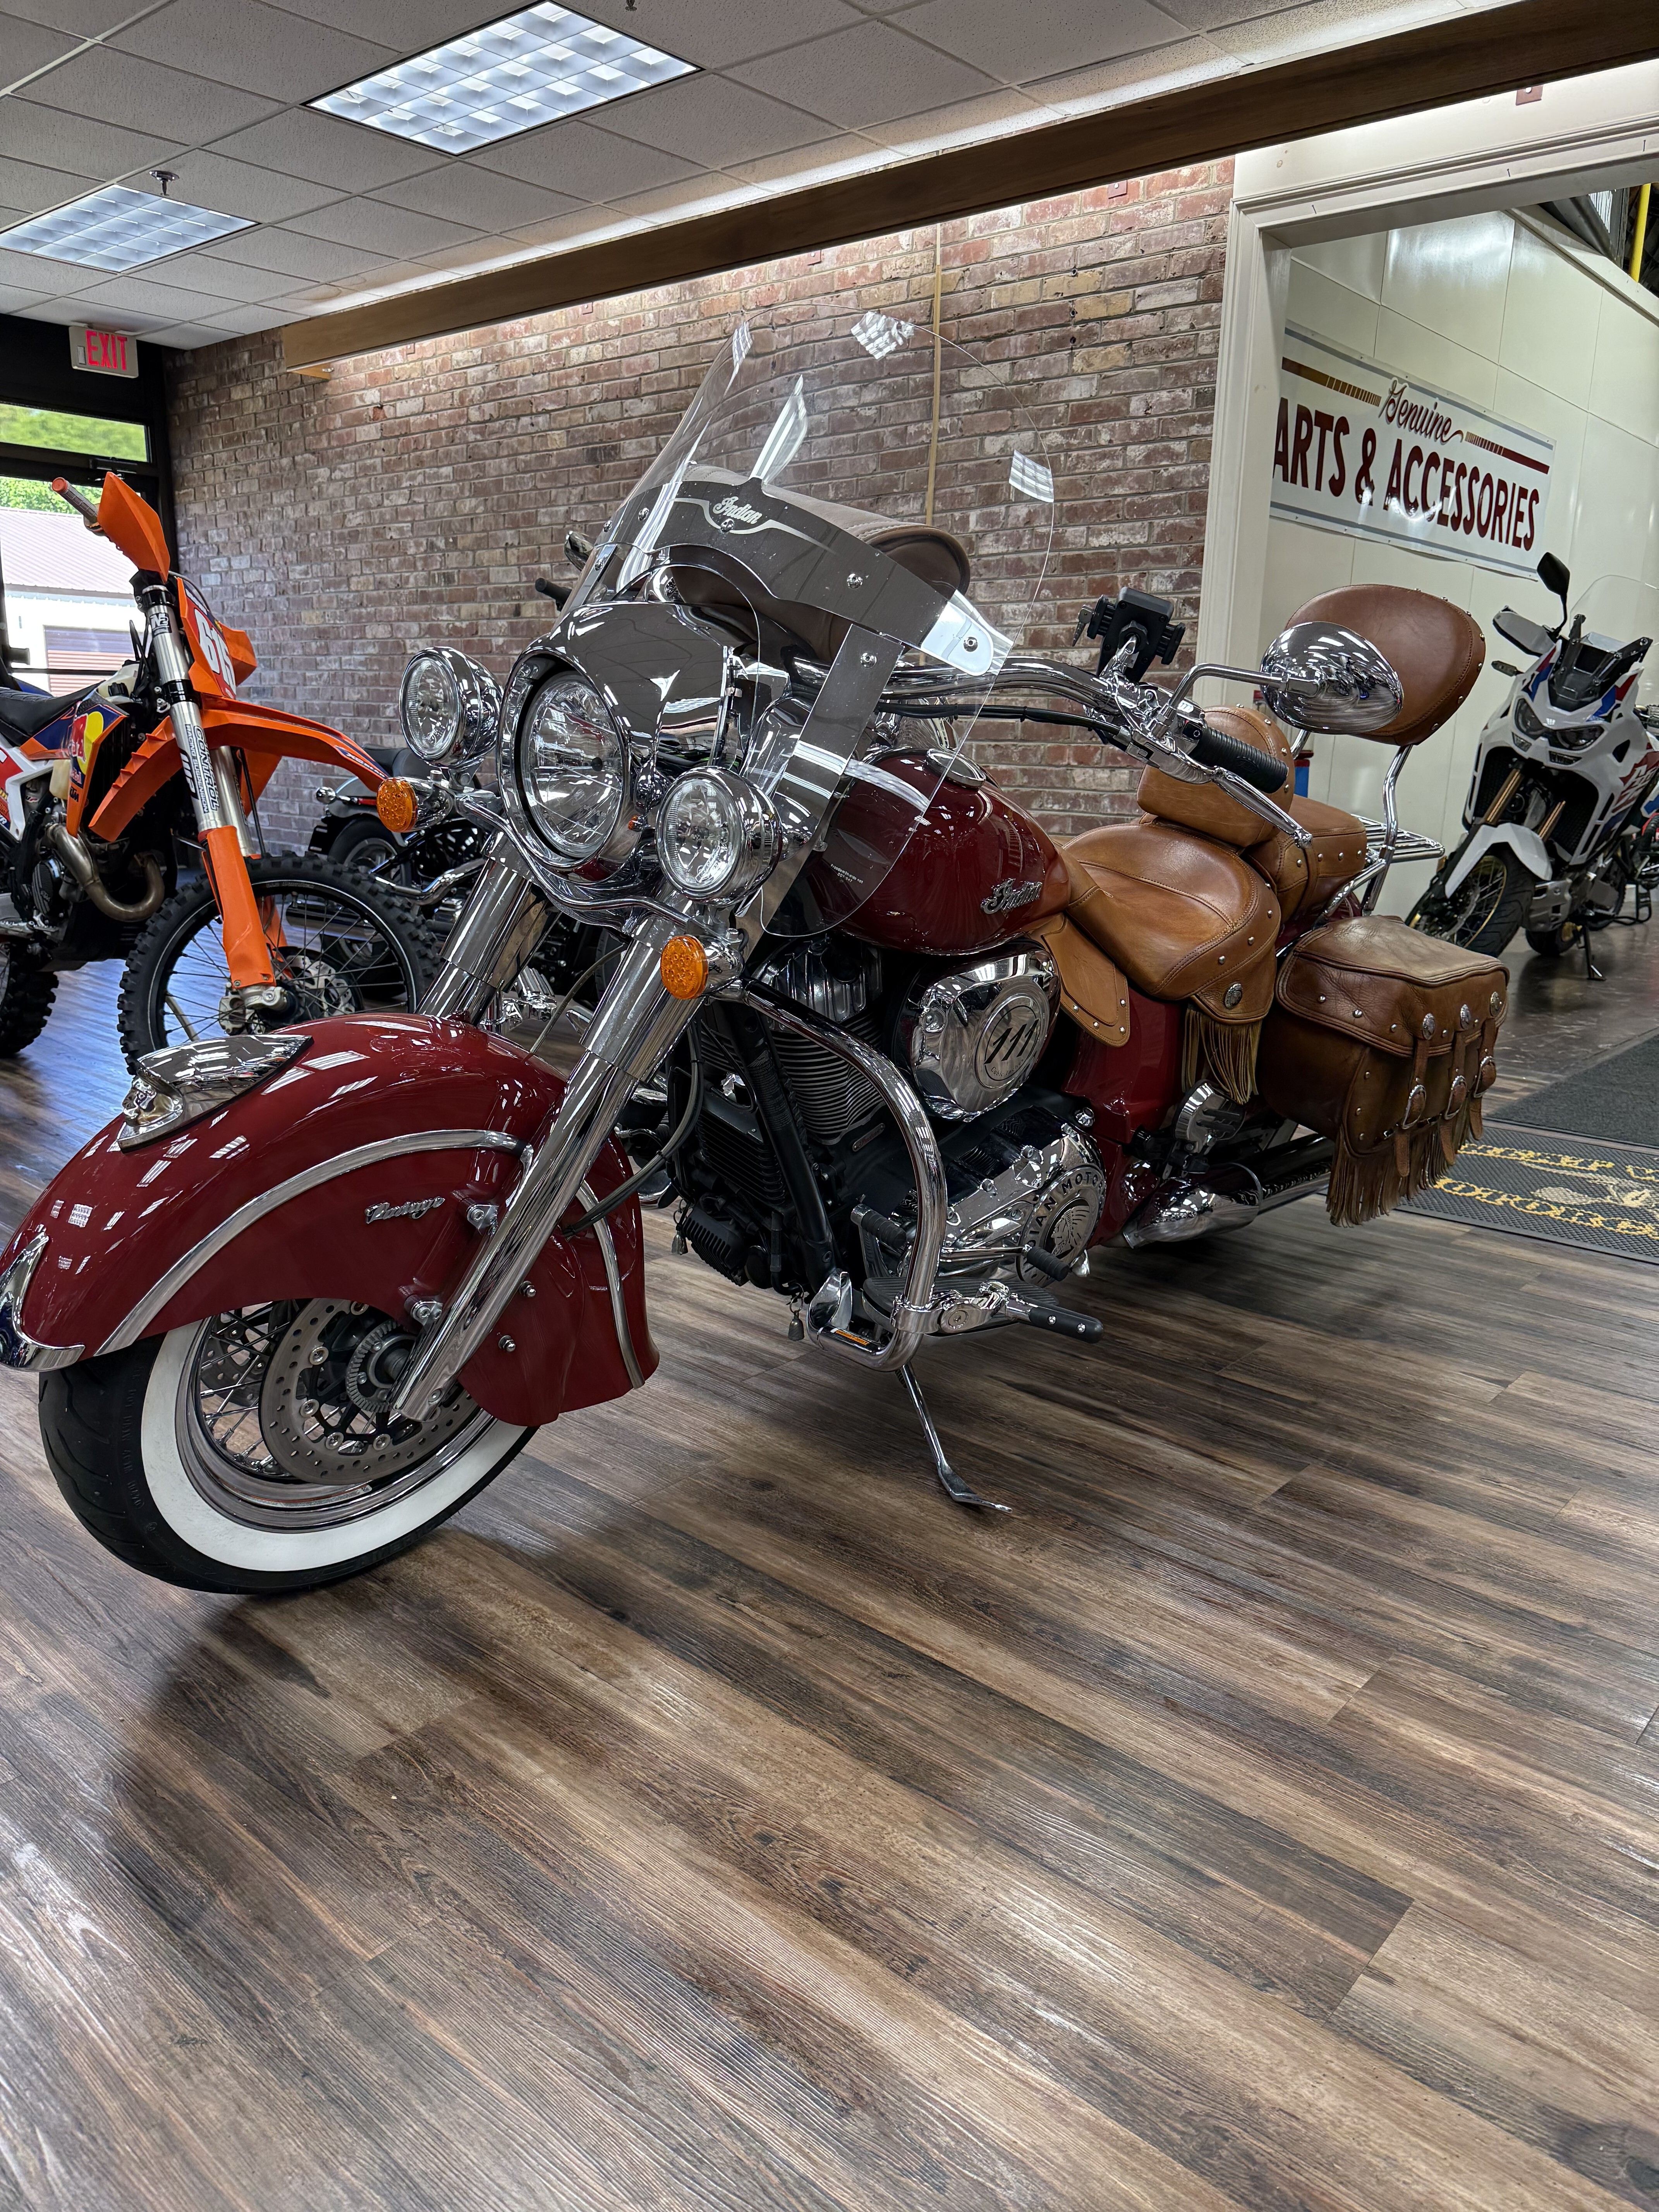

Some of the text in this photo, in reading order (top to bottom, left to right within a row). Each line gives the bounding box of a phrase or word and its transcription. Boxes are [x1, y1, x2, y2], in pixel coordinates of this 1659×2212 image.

[86, 330, 127, 371] EXIT
[1378, 380, 1463, 445] Genuine
[713, 496, 762, 524] Indian
[1355, 428, 1377, 506] &
[1383, 438, 1539, 551] ACCESSORIES
[185, 725, 210, 813] RACING SUSPENSION
[981, 878, 1043, 914] Indian
[984, 1019, 1039, 1064] 111
[991, 1066, 1004, 1077] Cubic
[365, 1197, 445, 1224] Vintage
